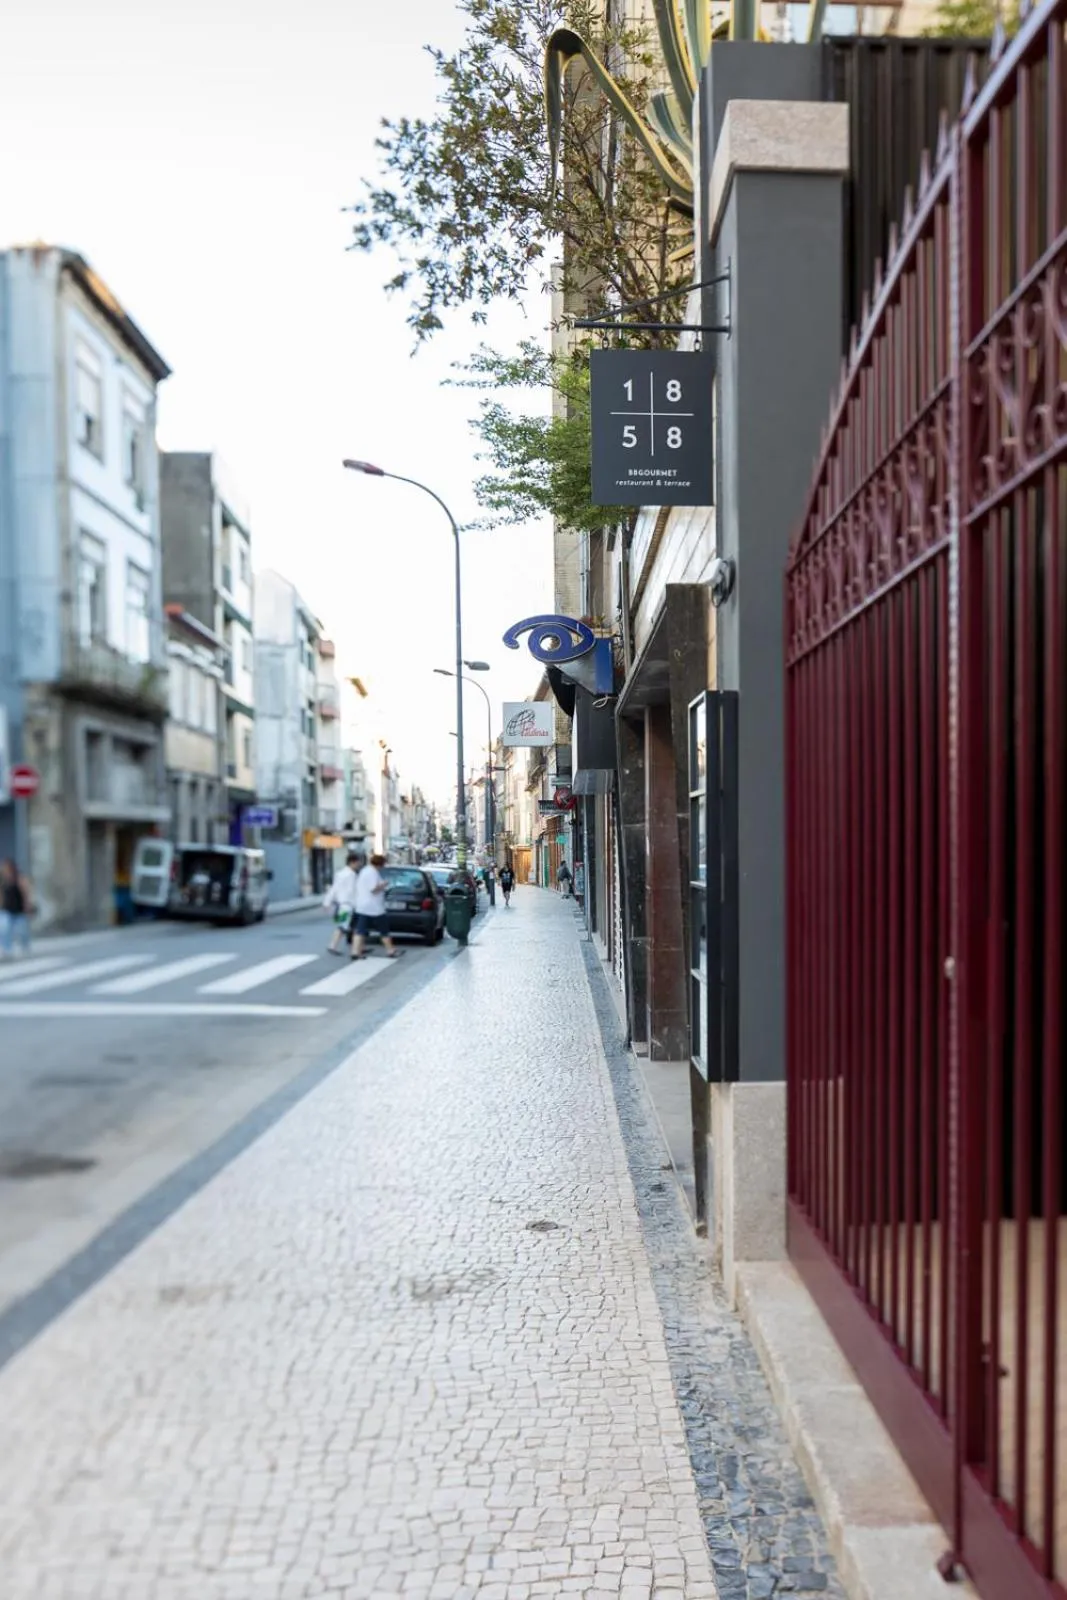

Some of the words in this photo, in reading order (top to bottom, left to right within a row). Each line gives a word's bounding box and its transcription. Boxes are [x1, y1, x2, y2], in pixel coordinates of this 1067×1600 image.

[623, 379, 633, 401] 1
[666, 379, 682, 402] 8
[621, 425, 638, 448] 5
[666, 426, 682, 449] 8
[615, 479, 654, 487] restaurant
[655, 479, 662, 487] &
